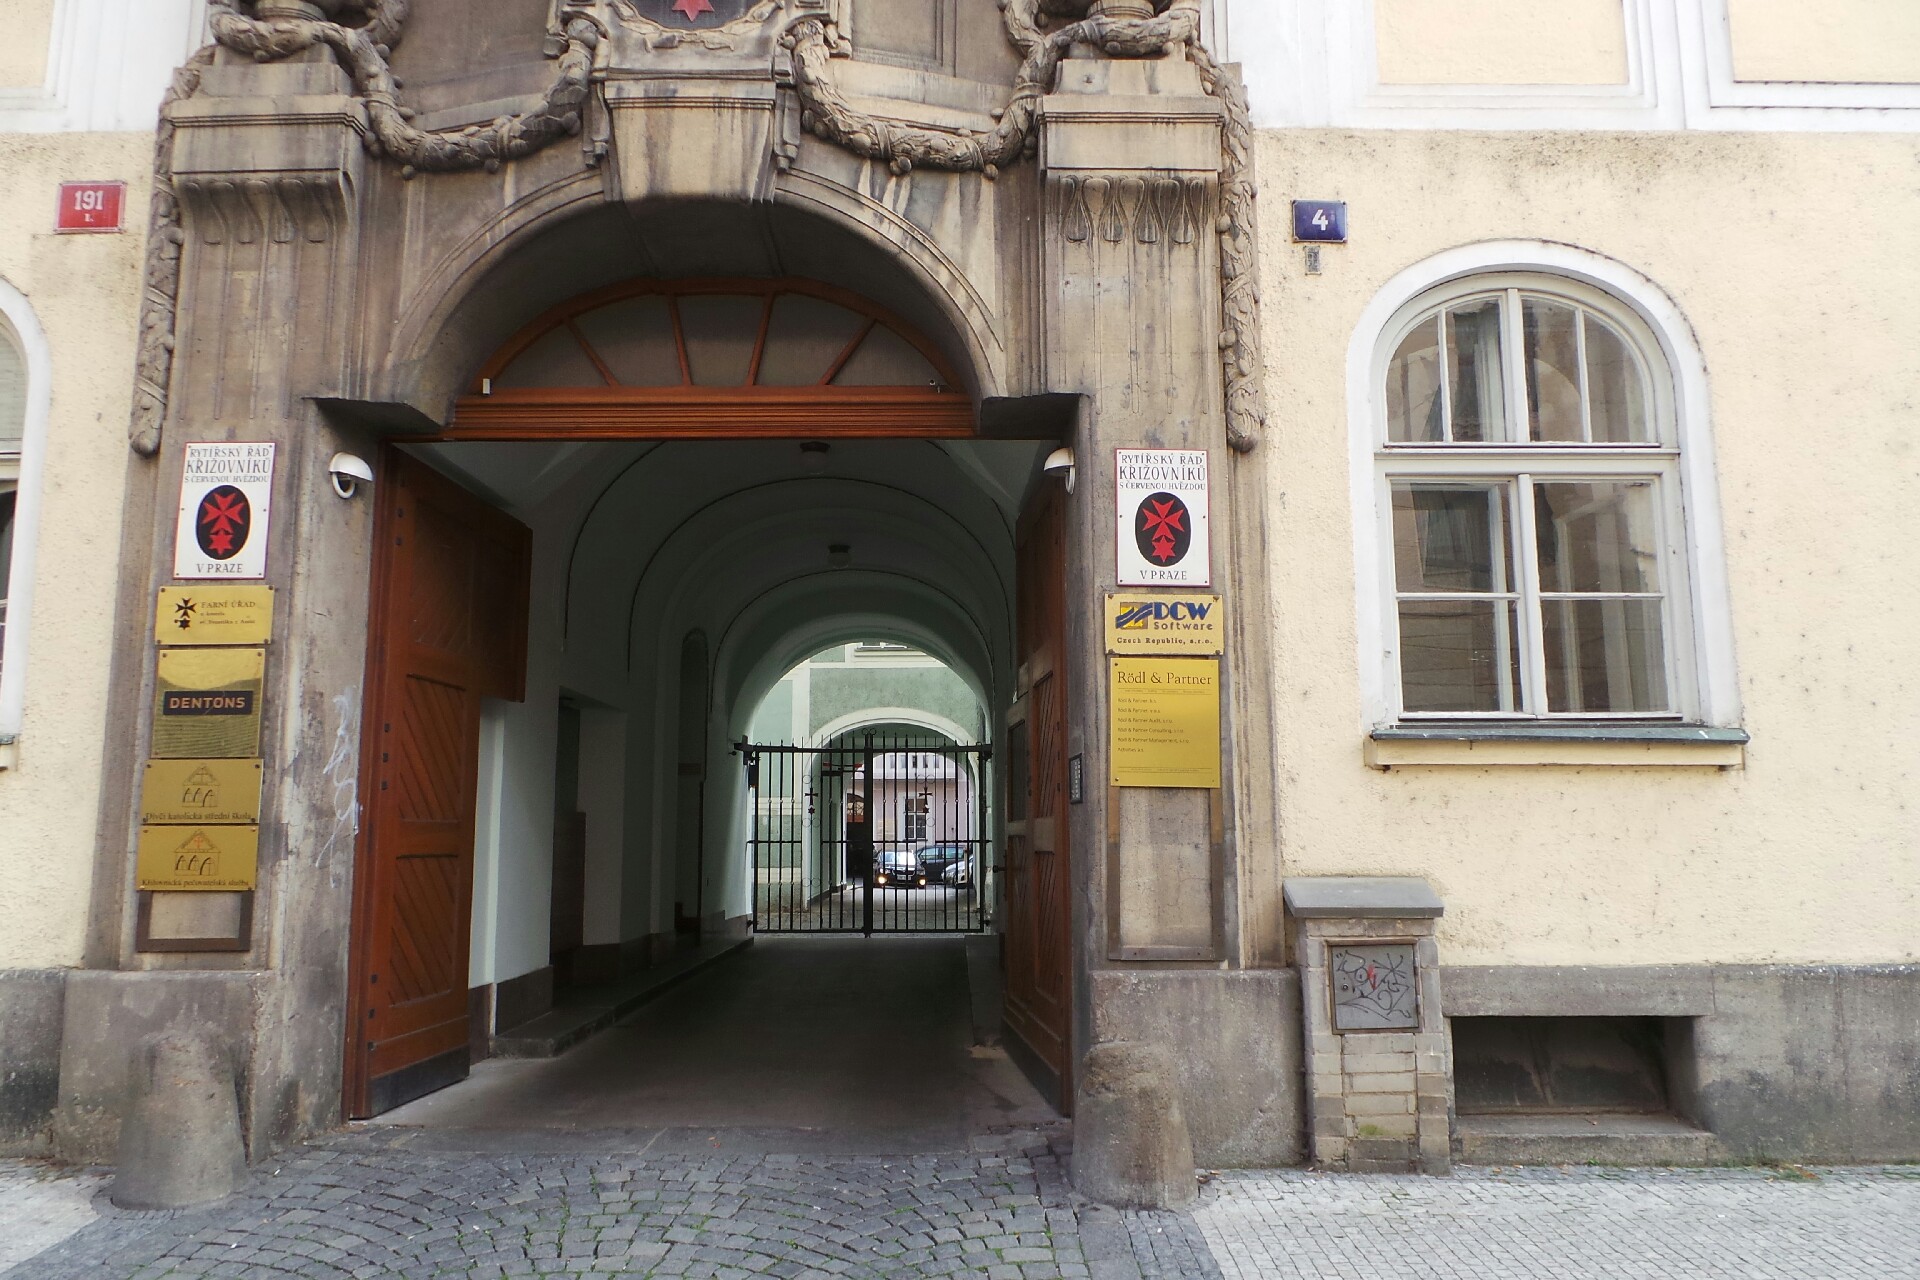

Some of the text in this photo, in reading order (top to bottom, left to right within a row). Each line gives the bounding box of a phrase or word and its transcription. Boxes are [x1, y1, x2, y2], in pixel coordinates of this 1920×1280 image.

[75, 190, 103, 210] 191
[1312, 209, 1328, 231] 4
[190, 445, 269, 457] RYTÍŘSKÝ ŘÁD
[1121, 453, 1203, 464] RYTÍŘSKÝ ŘÁD
[186, 458, 271, 473] KŘIŽOVNÍKŮ
[1119, 464, 1206, 480] KŘIŽOVNÍKŮ
[1126, 481, 1167, 490] ČERVENOU
[1168, 482, 1206, 490] HVĚZDOU
[197, 563, 243, 573] V PRAZE
[1139, 570, 1187, 580] V PRAZE
[1153, 601, 1212, 621] DCW
[1154, 622, 1213, 630] Software
[1145, 637, 1186, 645] Republic,
[1117, 671, 1212, 685] Rödl & Partner
[169, 697, 246, 709] DENTONS
